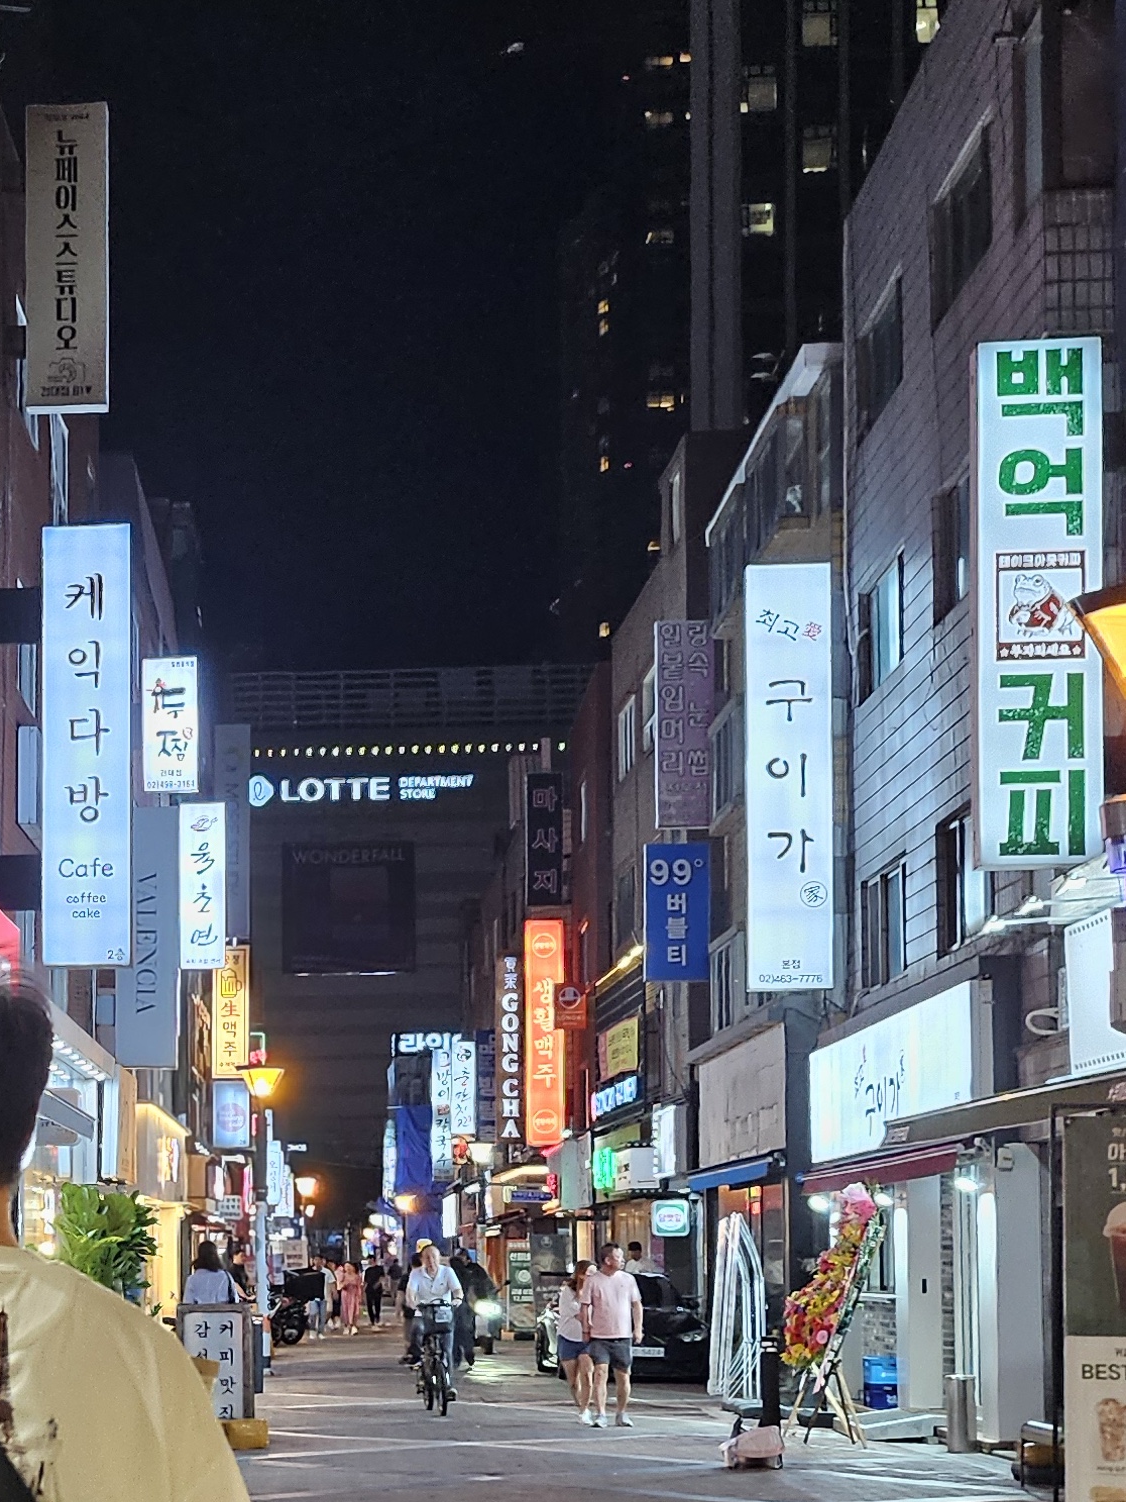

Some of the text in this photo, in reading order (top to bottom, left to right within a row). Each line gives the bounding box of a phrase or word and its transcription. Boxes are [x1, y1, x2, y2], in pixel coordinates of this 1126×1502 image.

[55, 129, 79, 351] 뉴페이스스튜디오
[995, 346, 1084, 538] 백억
[998, 552, 1082, 569] 테이크아웃커피
[63, 572, 111, 824] 케익다방
[280, 773, 475, 802] LOTTE DEPARTMENT
[399, 787, 436, 800] STORE
[765, 678, 813, 873] 구이가
[995, 671, 1086, 857] 커피
[58, 857, 114, 878] Cafe
[532, 786, 559, 894] 마사지
[66, 891, 107, 904] coffee
[72, 907, 101, 919] cake
[665, 892, 688, 967] 버블티
[135, 872, 158, 1014] VALENCIA
[781, 958, 802, 970] 본점
[501, 992, 521, 1138] GONG CHA
[865, 1071, 901, 1137] 구이가
